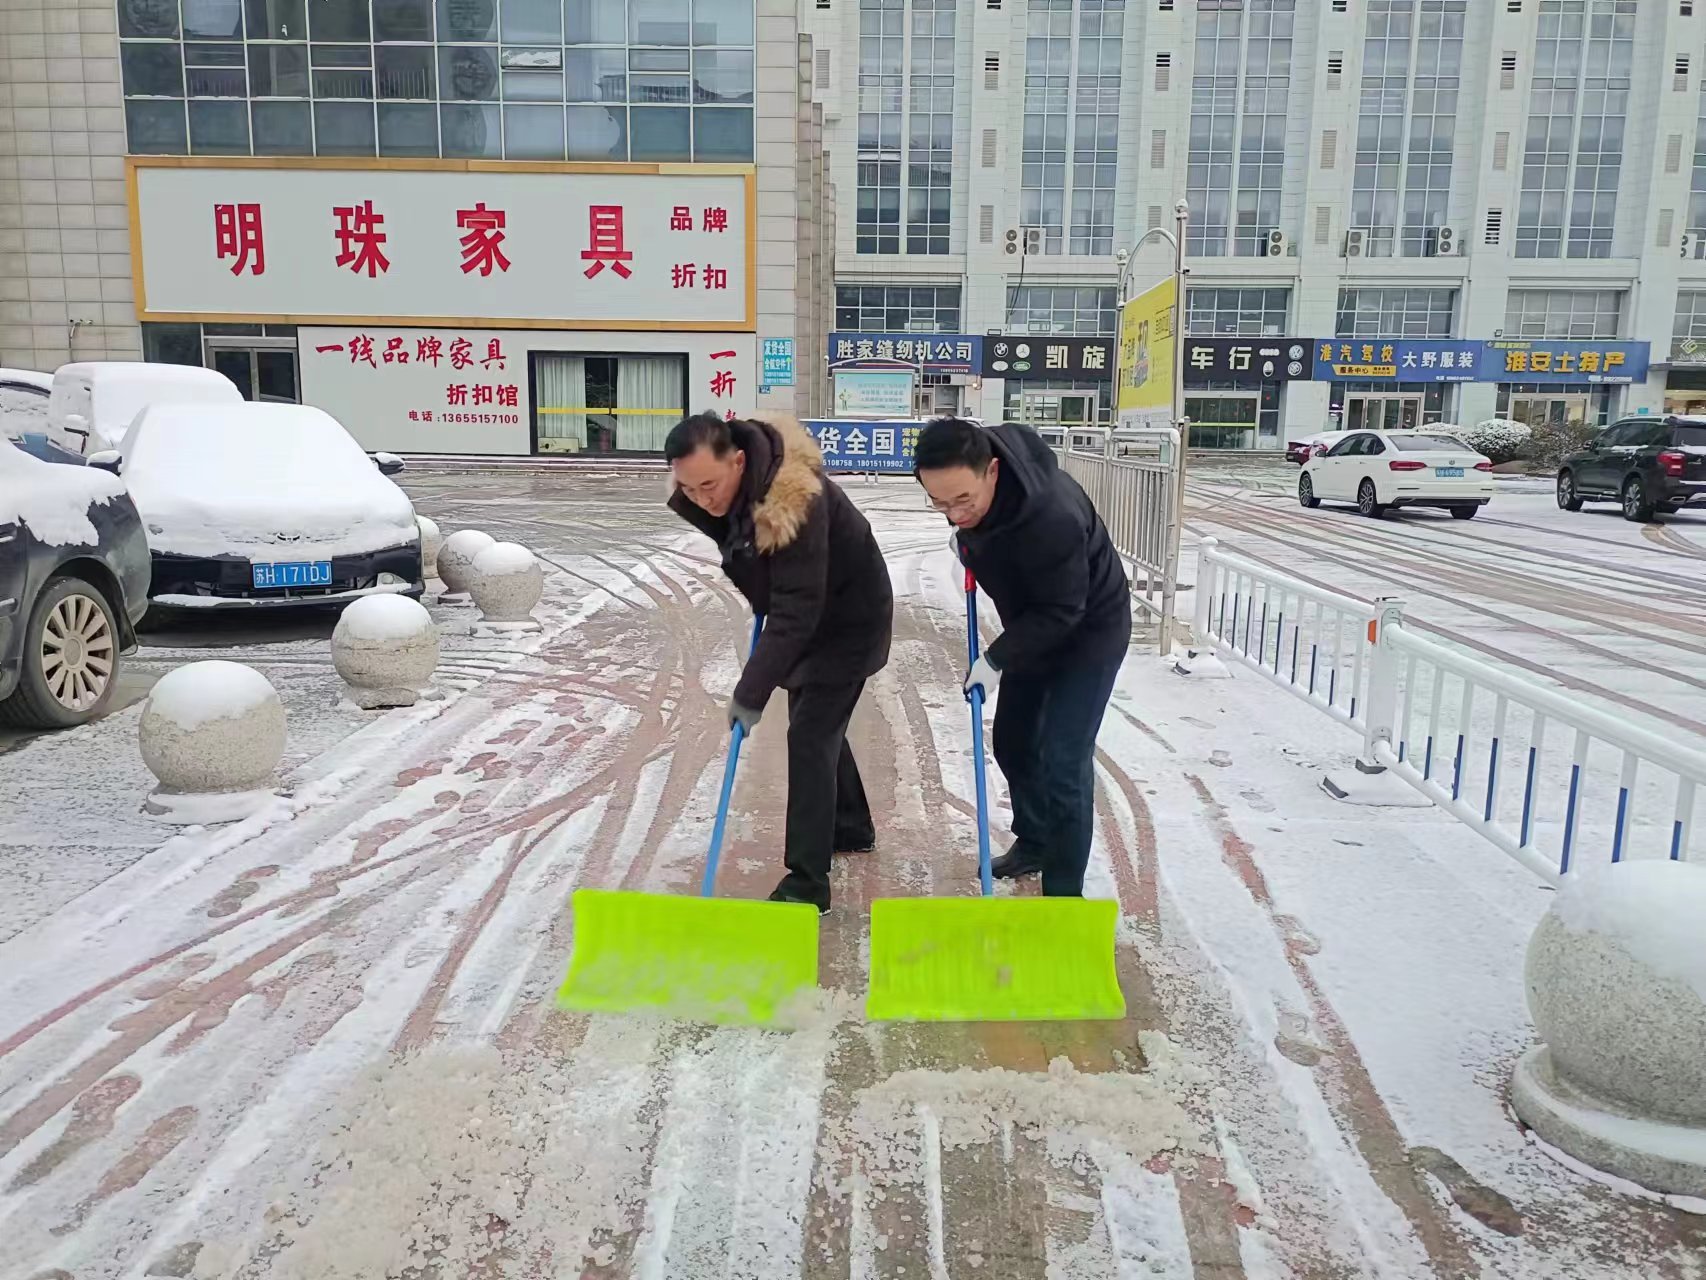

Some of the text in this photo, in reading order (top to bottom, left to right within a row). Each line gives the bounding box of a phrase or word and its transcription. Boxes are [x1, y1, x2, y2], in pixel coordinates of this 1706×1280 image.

[671, 206, 728, 232] 品牌
[214, 200, 632, 280] 明珠家具
[671, 263, 726, 289] 折扣
[315, 333, 507, 370] 一线品牌家具
[836, 339, 973, 361] 胜家缝纫机公司
[1046, 345, 1106, 369] 凯旋
[1190, 346, 1252, 370] 车行
[1319, 344, 1394, 363] 淮汽驾校
[1401, 351, 1474, 369] 大野服装
[1504, 350, 1626, 373] 淮安土特产
[446, 383, 519, 407] 折扣馆
[806, 427, 895, 455] 货全国
